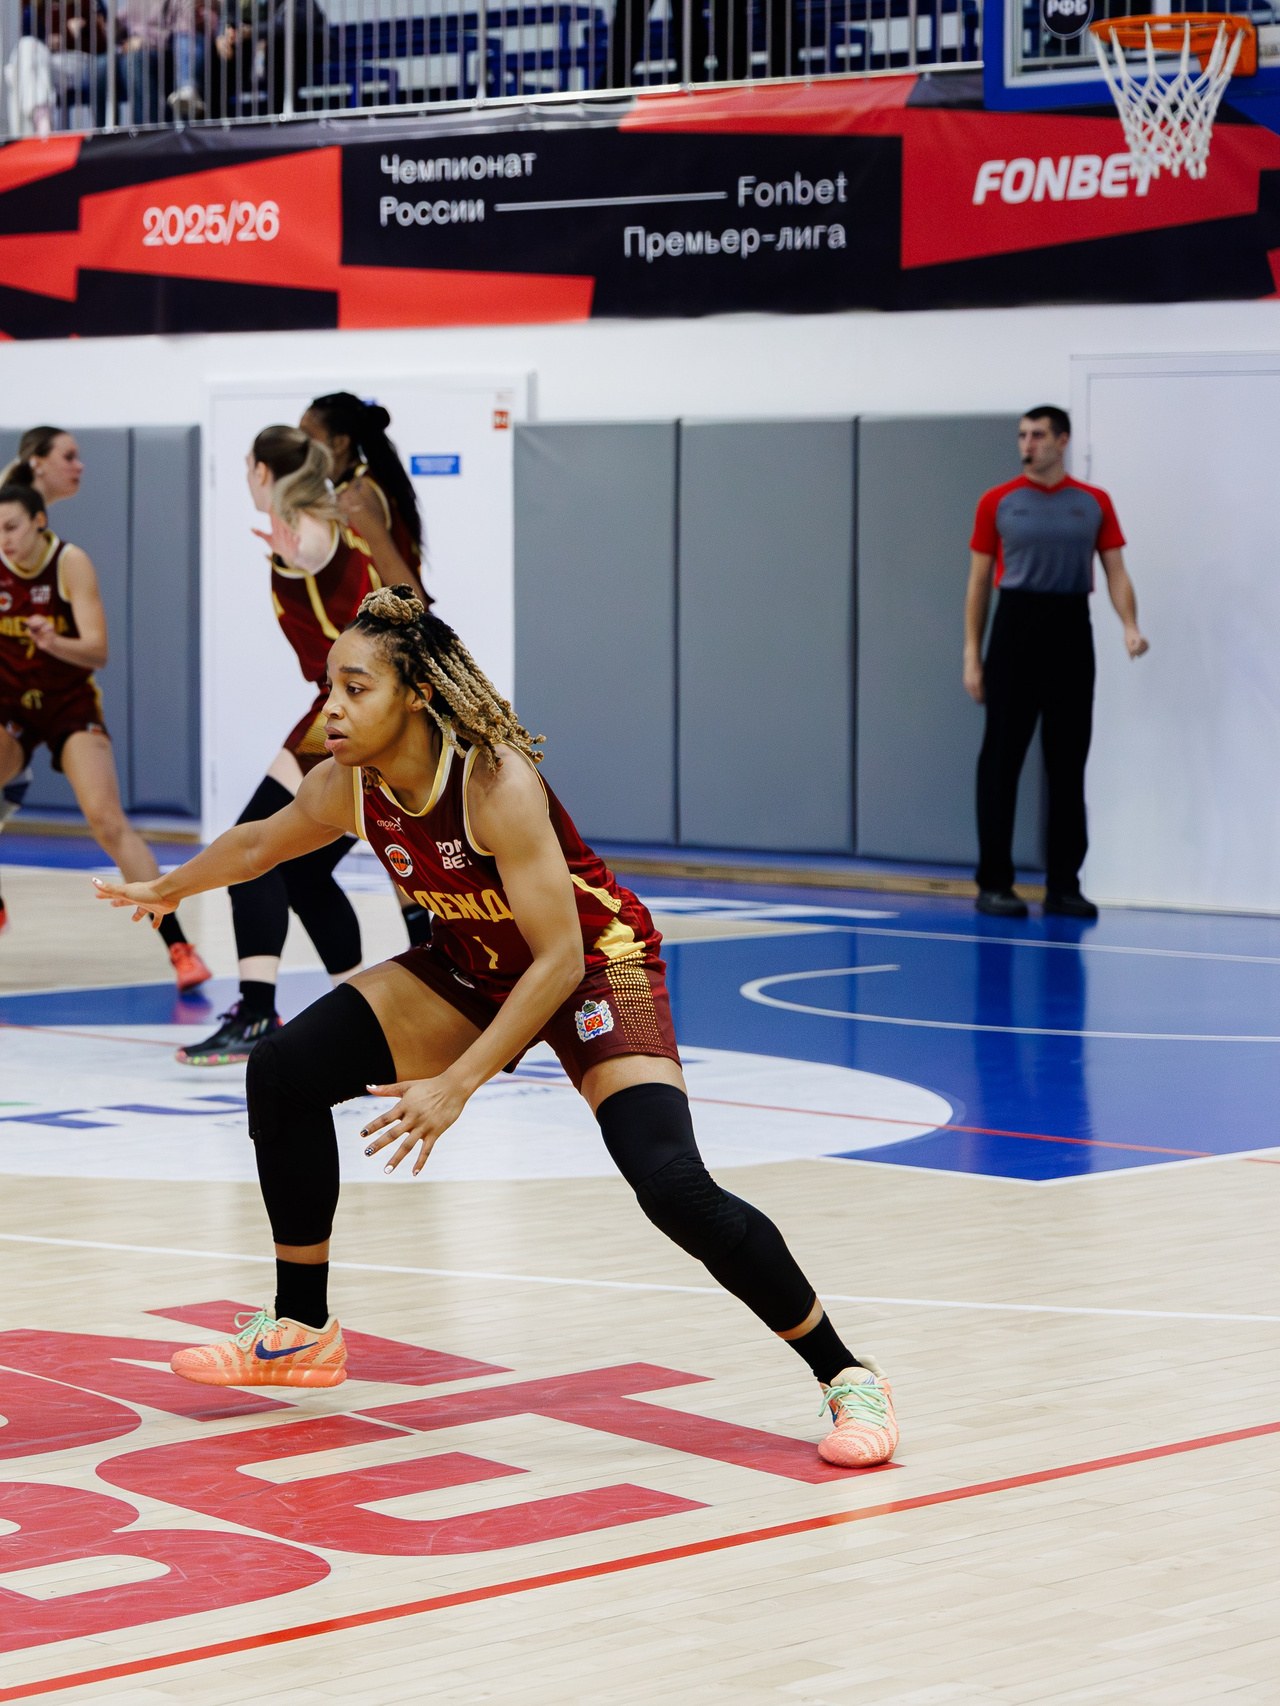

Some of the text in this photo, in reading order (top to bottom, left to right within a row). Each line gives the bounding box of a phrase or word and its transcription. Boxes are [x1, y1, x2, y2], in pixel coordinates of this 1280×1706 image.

[380, 152, 537, 184] Чемпионат
[380, 170, 848, 227] России Fonbet
[143, 200, 280, 246] 2025/26
[624, 223, 847, 263] Премьер-лига
